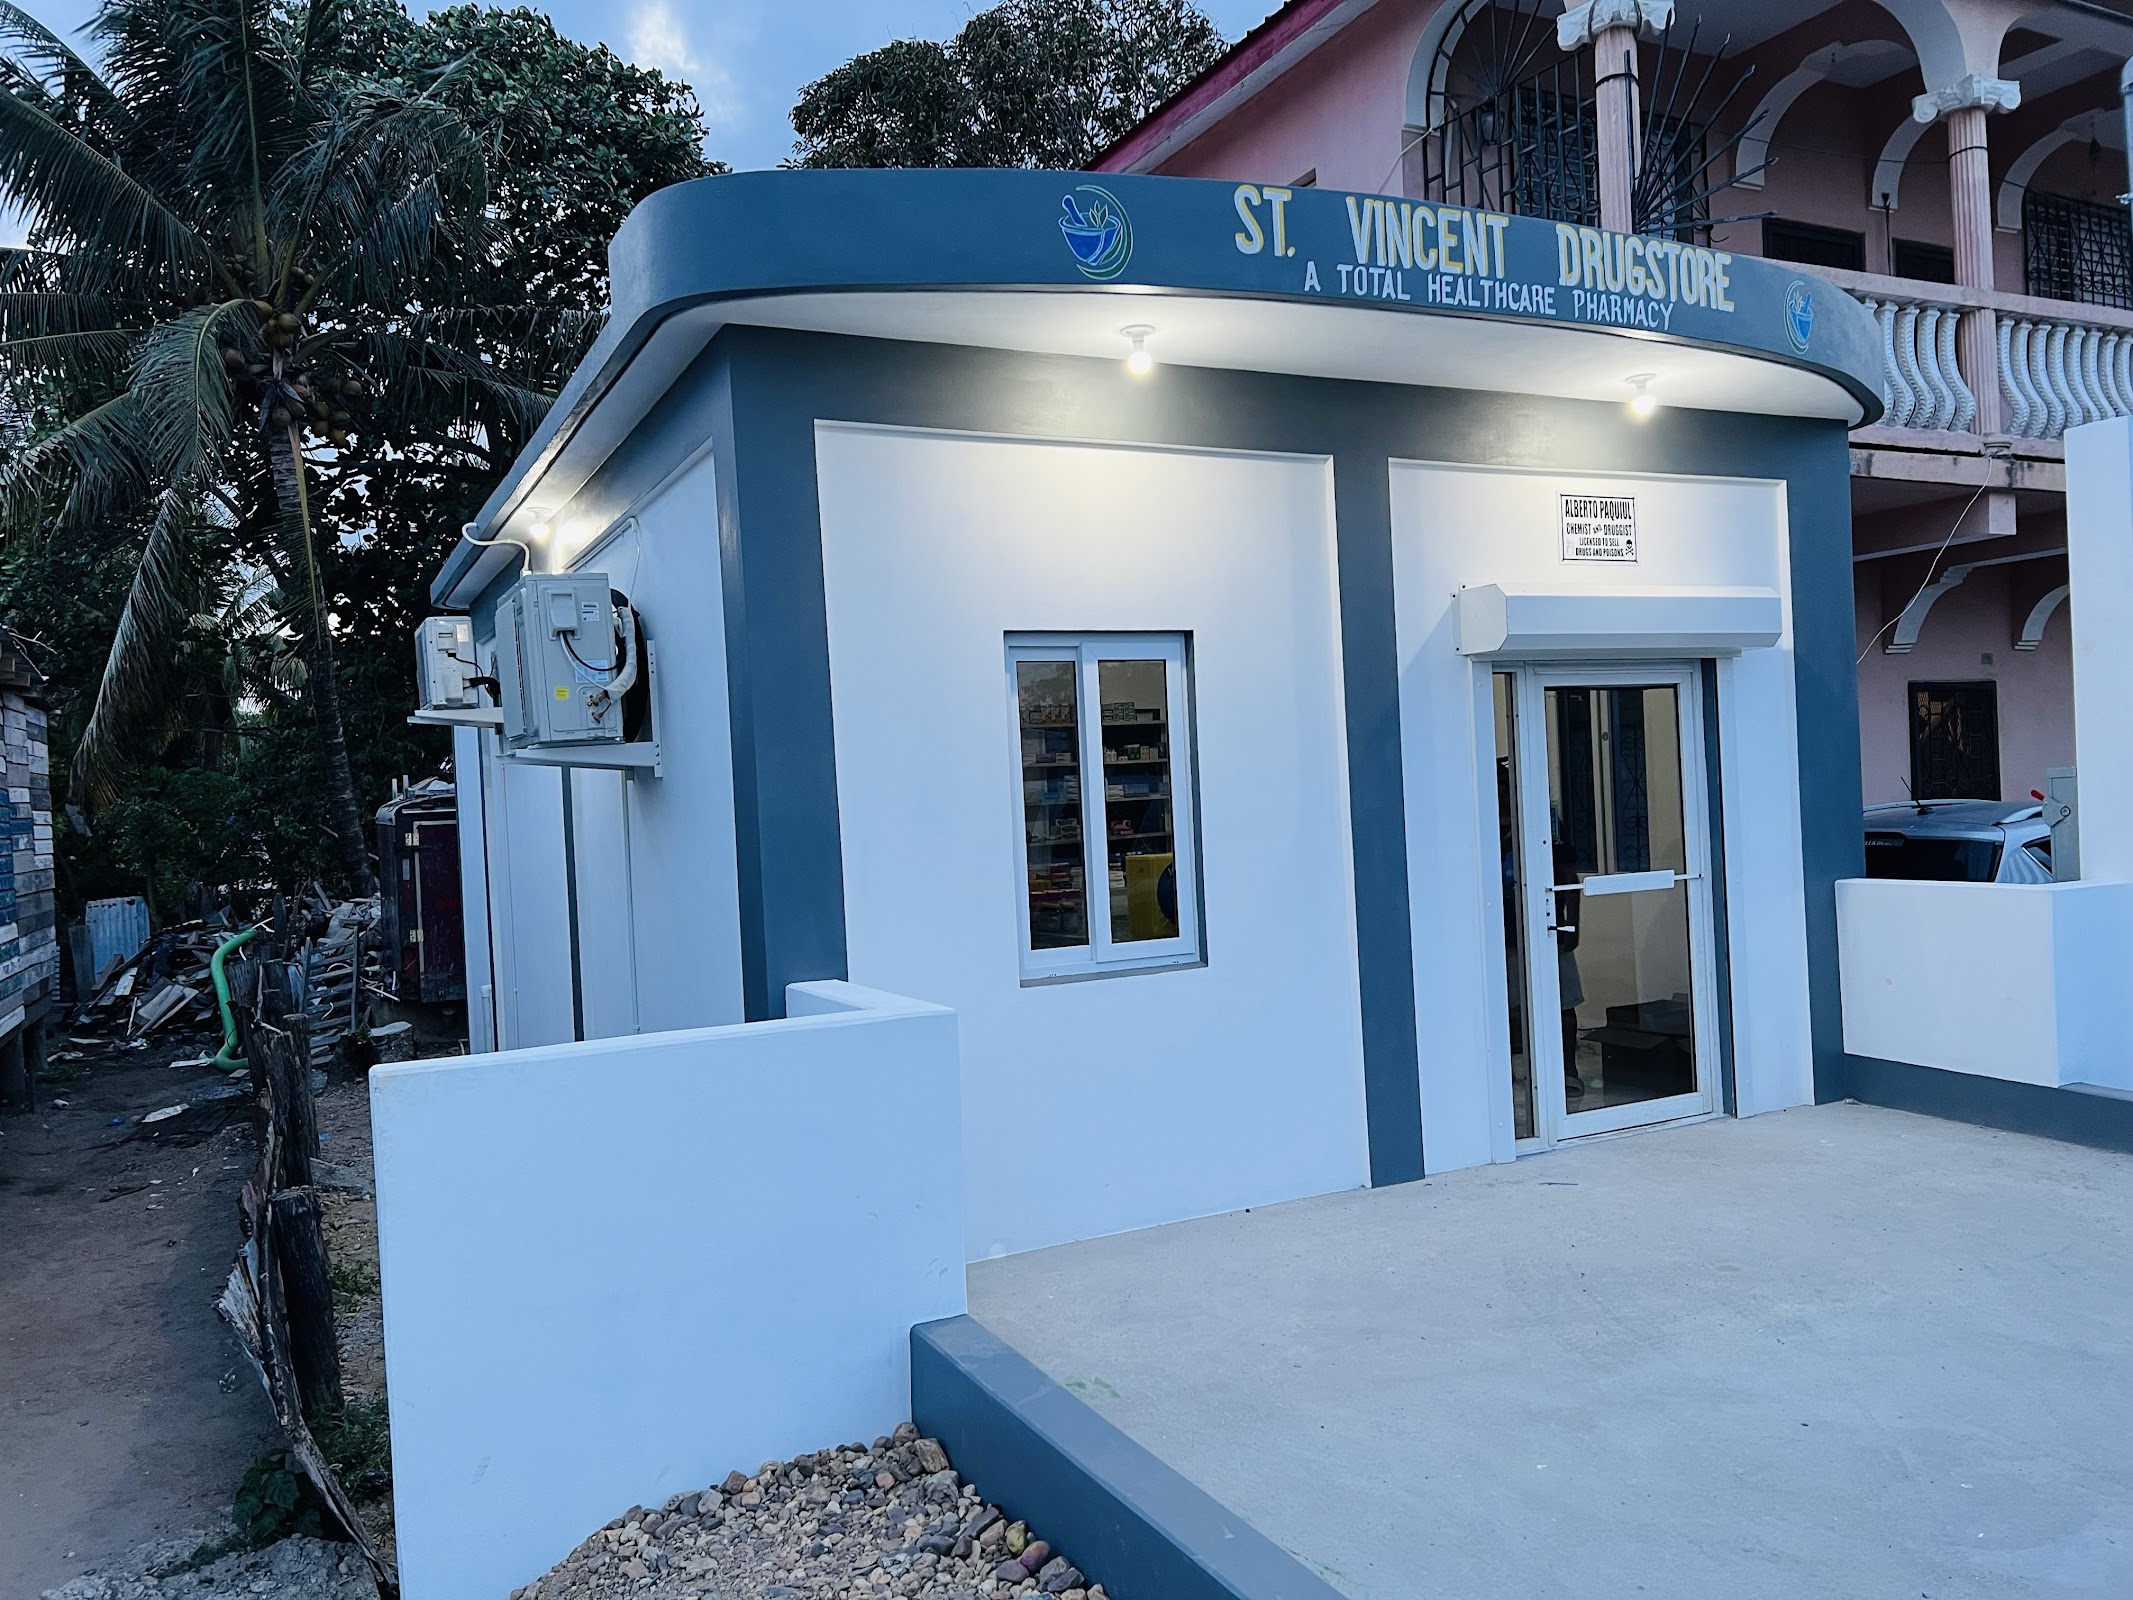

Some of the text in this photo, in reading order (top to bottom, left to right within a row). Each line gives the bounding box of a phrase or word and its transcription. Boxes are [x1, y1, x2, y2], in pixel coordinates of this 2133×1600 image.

[1234, 184, 1734, 312] ST. VINCENT DRUGSTORE
[1304, 261, 1674, 331] A TOTAL HEALTHCARE PHARMACY
[1565, 499, 1598, 518] ALBERTO
[1566, 522, 1632, 536] CHEMIST AND DRUGGIST
[1579, 537, 1619, 546] LICENSED TO SELL
[1575, 547, 1592, 556] DRUGS
[1592, 548, 1602, 557] AND
